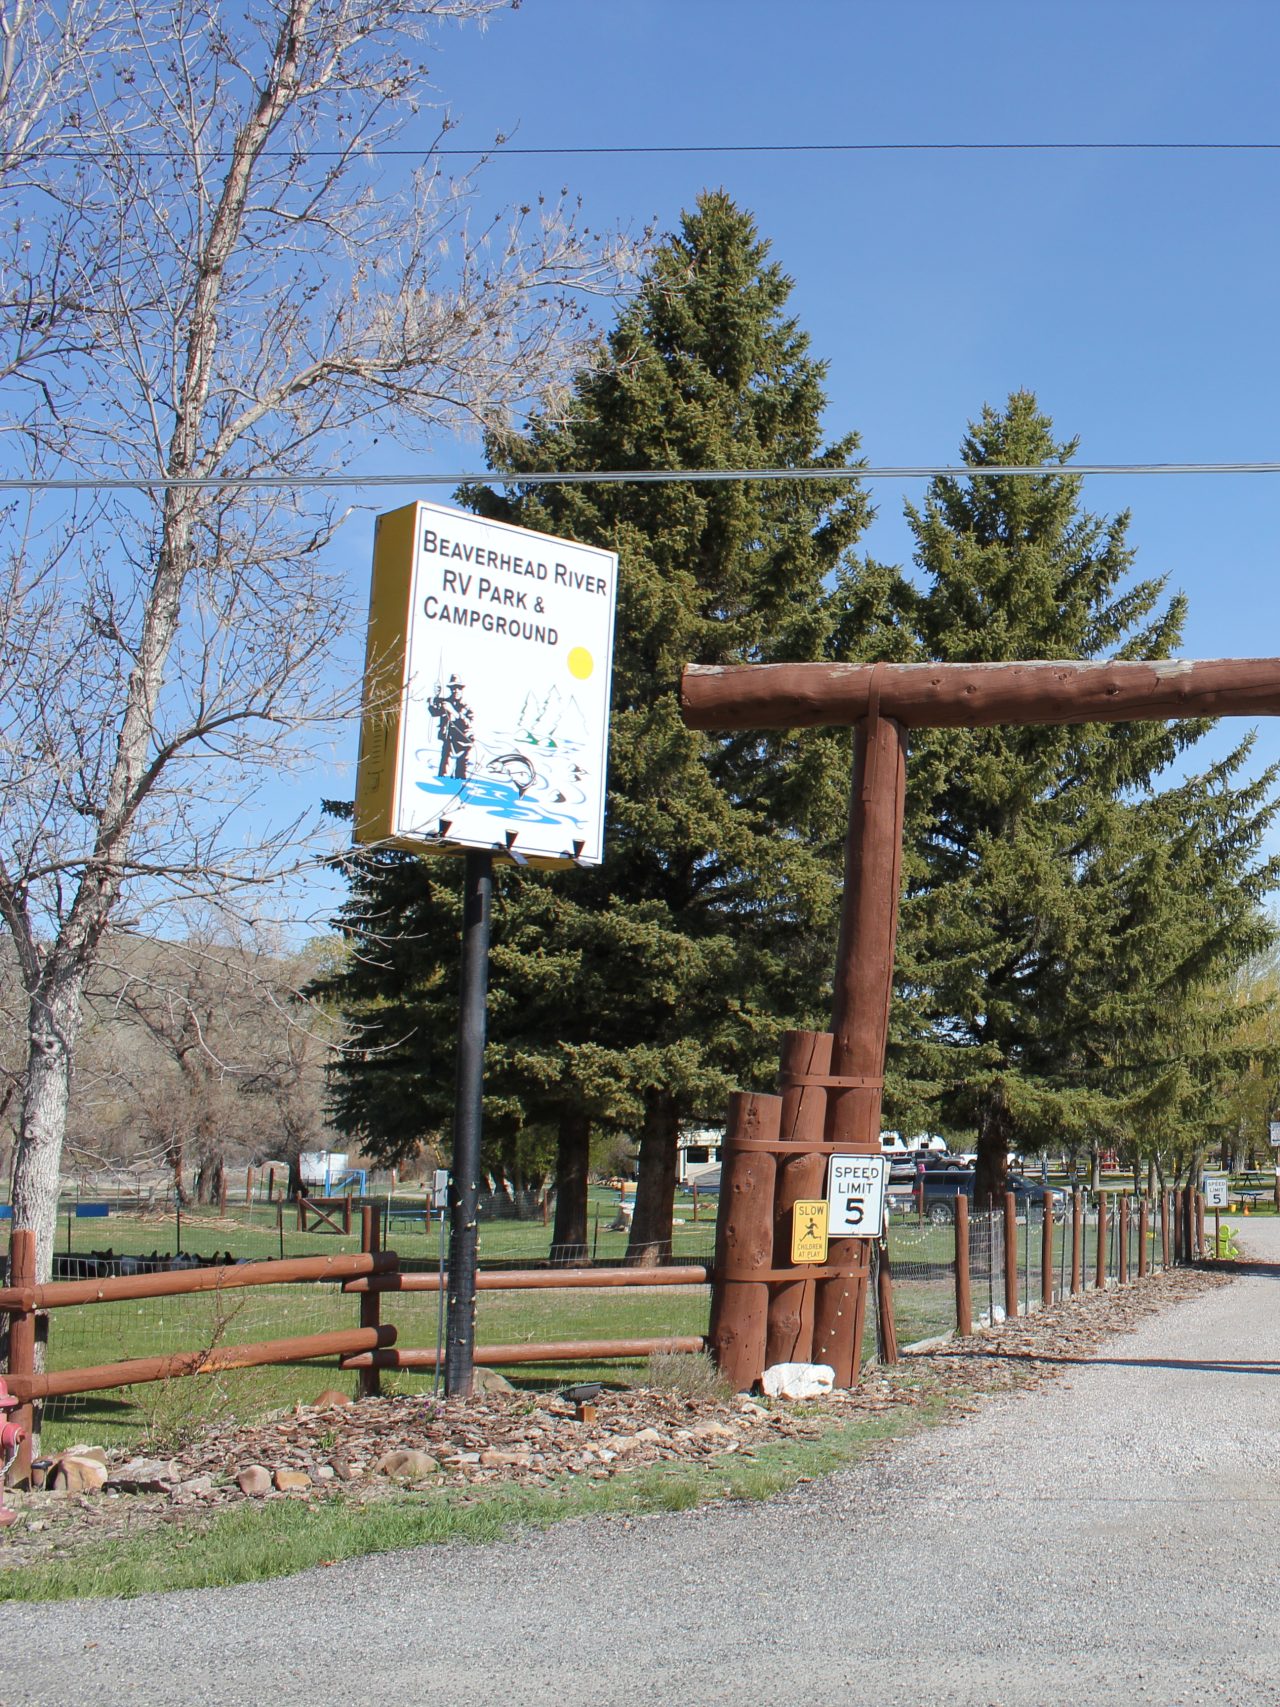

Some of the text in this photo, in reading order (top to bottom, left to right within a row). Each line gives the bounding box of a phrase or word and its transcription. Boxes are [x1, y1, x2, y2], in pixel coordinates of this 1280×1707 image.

[423, 530, 607, 596] BEAVERHEAD RIVER
[442, 569, 545, 614] RV PARK &
[423, 595, 559, 645] CAMPGROUND
[835, 1167, 879, 1179] SPEED
[838, 1183, 874, 1194] LIMIT
[1213, 1194, 1221, 1204] 5
[799, 1206, 825, 1216] SLOW
[844, 1198, 865, 1225] 5
